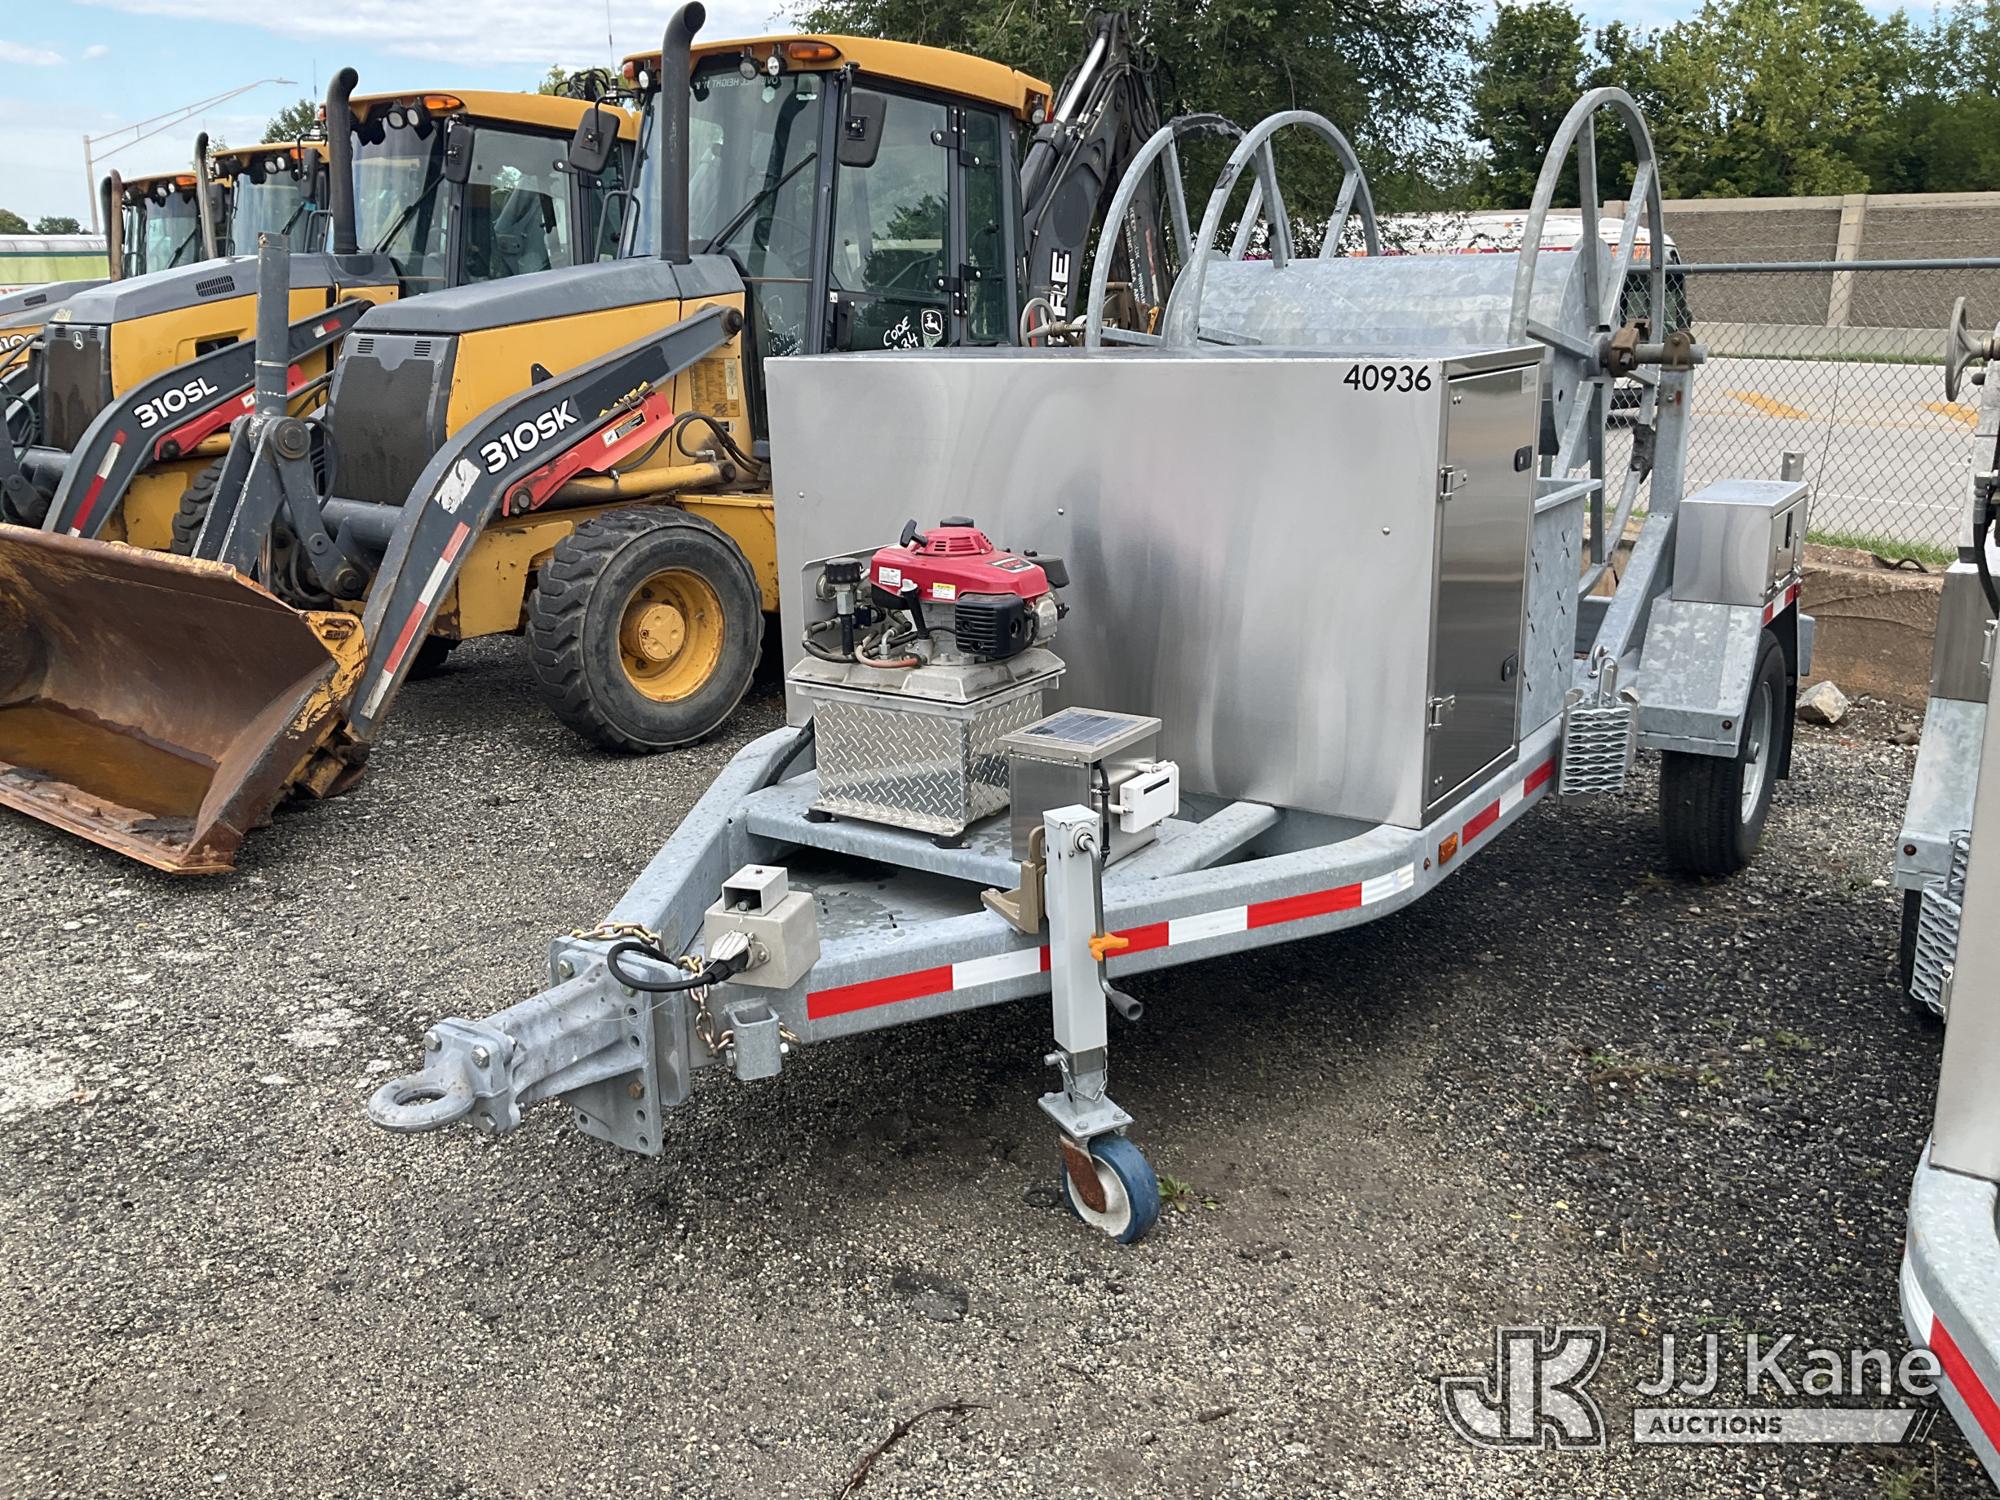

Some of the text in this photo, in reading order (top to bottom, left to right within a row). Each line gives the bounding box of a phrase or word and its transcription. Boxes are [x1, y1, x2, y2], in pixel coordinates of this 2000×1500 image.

[883, 315, 912, 347] CODE
[1343, 364, 1432, 392] 40936
[133, 377, 219, 430] 310SL
[480, 399, 578, 474] 310SK
